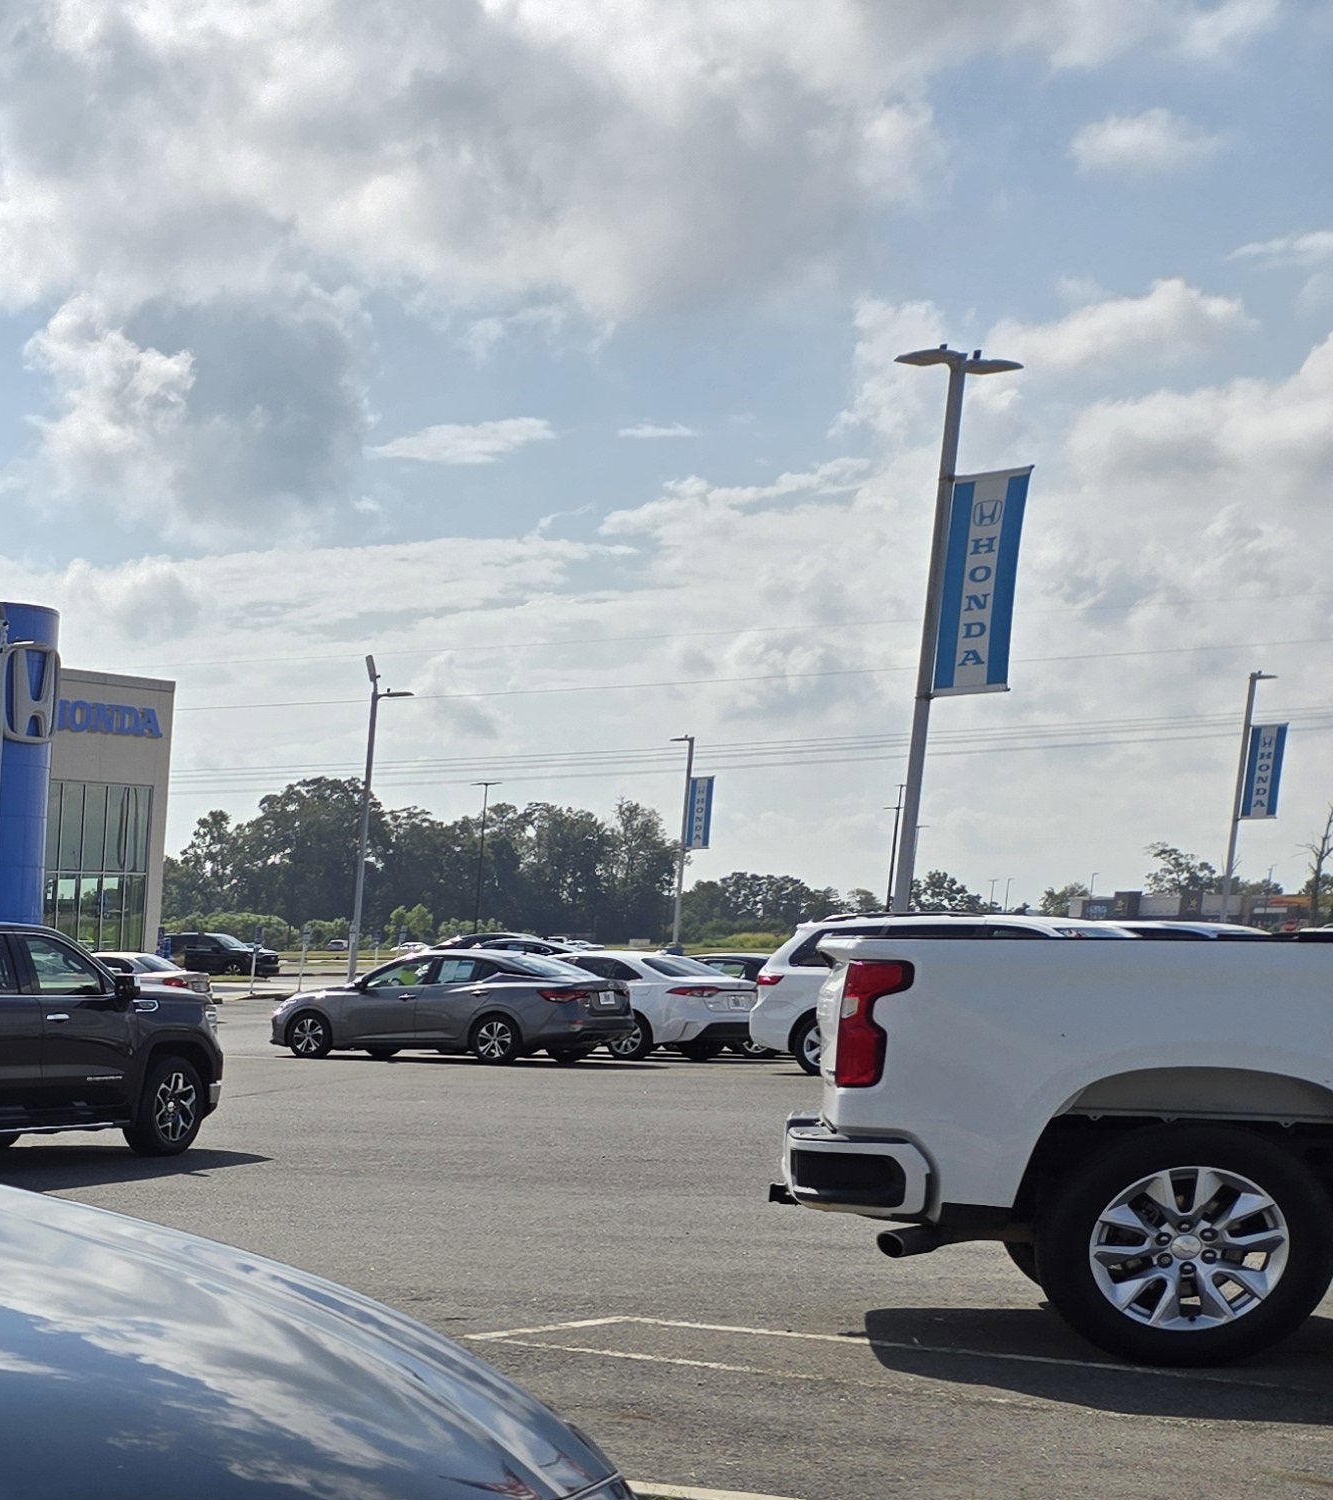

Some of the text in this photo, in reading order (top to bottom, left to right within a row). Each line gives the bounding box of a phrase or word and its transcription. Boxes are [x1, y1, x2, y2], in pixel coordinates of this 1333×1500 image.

[957, 536, 997, 666] HONDA
[1253, 752, 1272, 808] HONDA
[694, 798, 704, 840] HONDA
